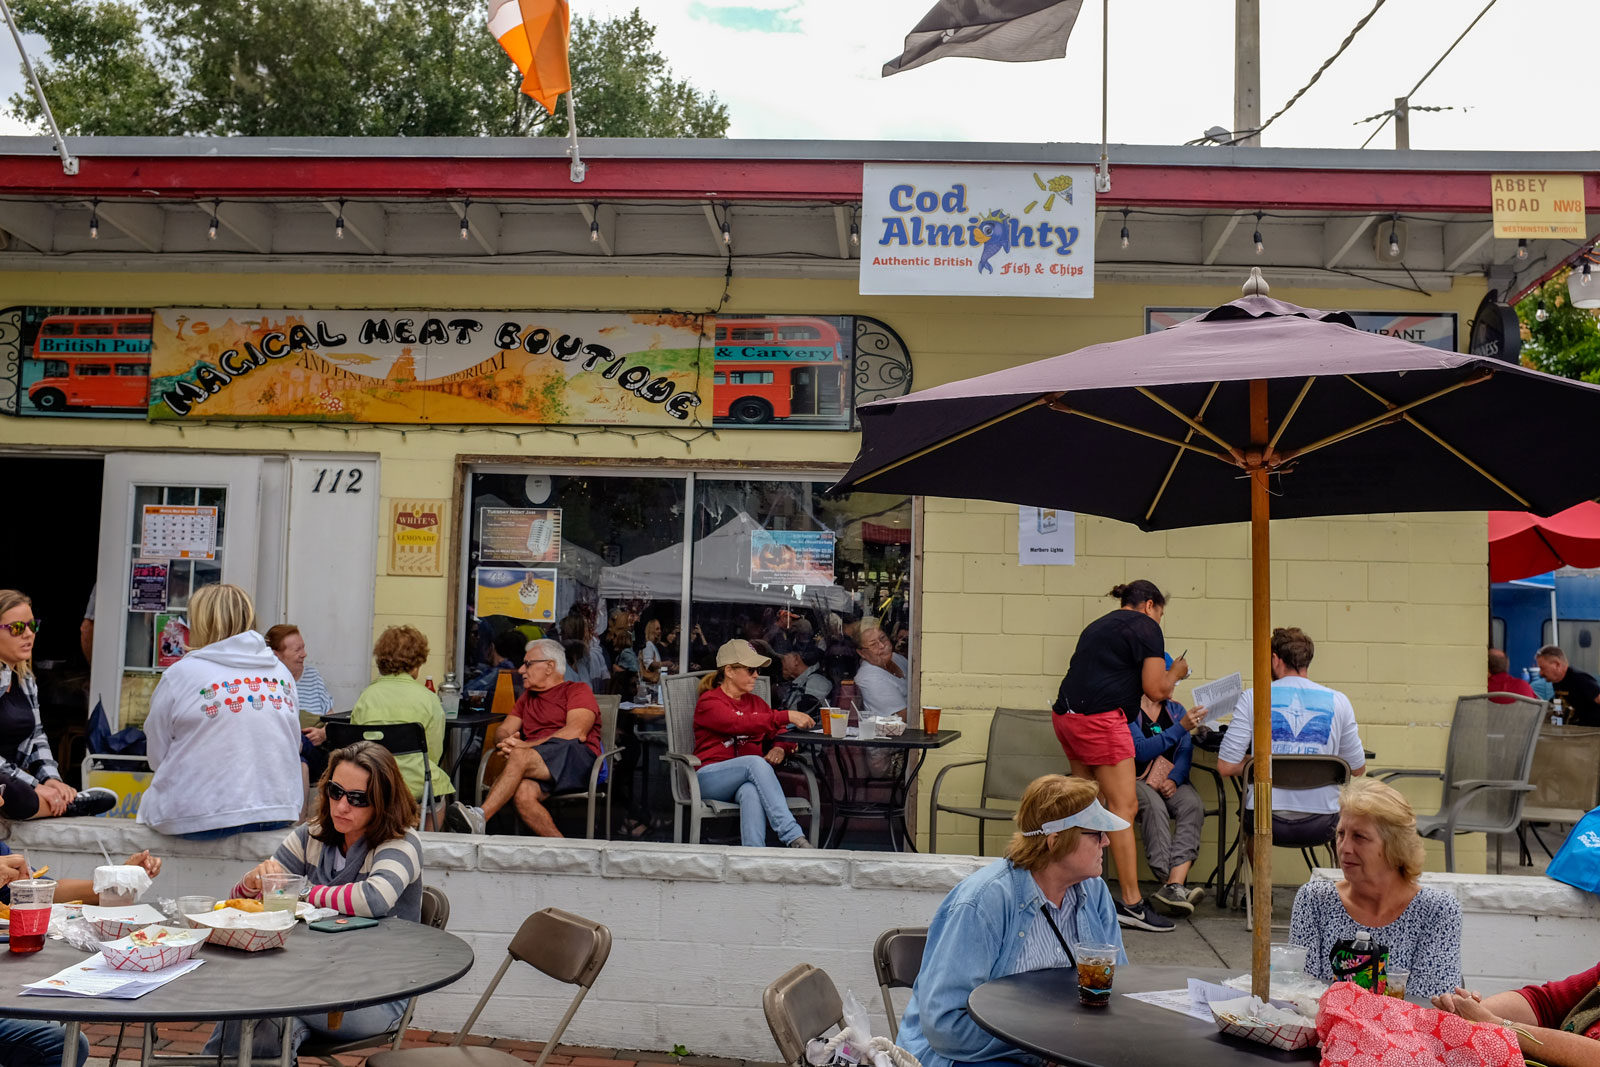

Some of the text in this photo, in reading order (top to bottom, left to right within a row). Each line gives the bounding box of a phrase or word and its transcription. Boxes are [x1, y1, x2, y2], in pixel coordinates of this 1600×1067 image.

[1494, 179, 1548, 192] ABBEY
[889, 184, 968, 213] Cod
[1495, 199, 1582, 212] ROAD NW8
[878, 216, 1080, 256] Almihty
[1502, 225, 1550, 233] WESTMINSTER
[872, 256, 973, 267] Authentic British
[1000, 262, 1084, 276] Fish & Chips
[42, 338, 150, 352] British Pub
[716, 347, 833, 361] & Carvery
[161, 318, 702, 421] MAGICAL MEAT BOUTIQUE
[296, 352, 331, 375] AND
[441, 351, 508, 384] EMPORIUM
[312, 468, 363, 493] 112
[399, 516, 436, 525] WHITE'S
